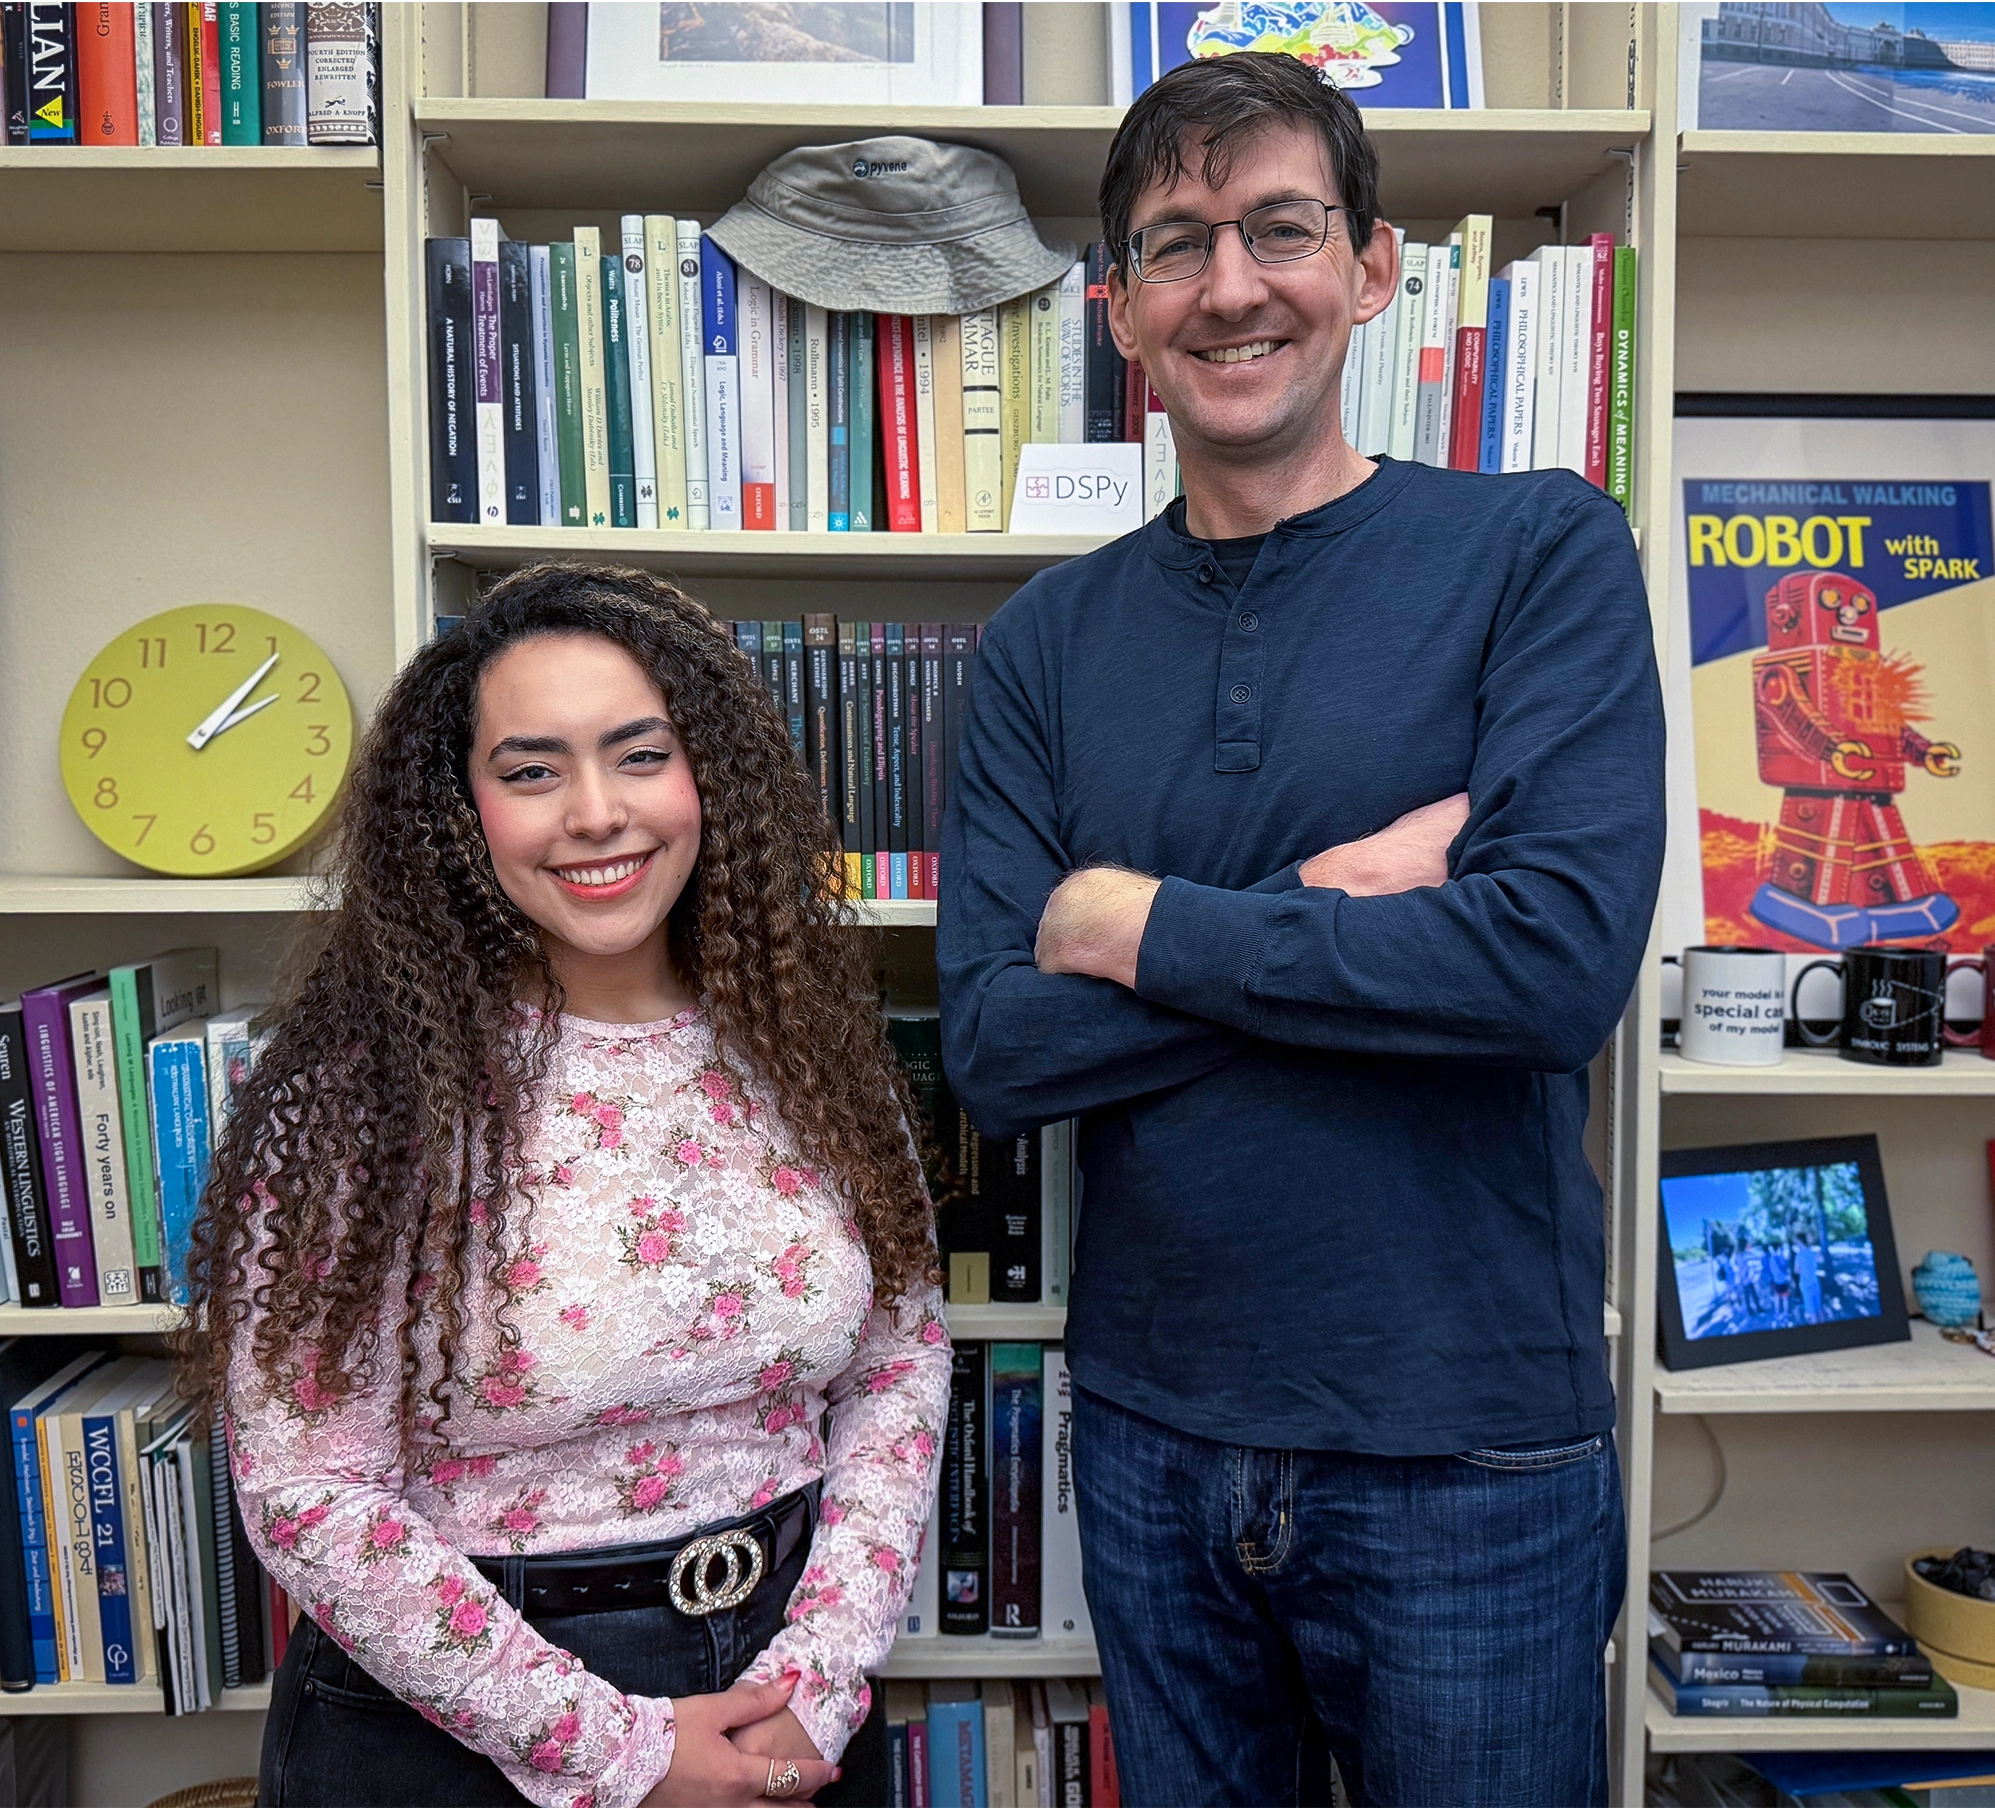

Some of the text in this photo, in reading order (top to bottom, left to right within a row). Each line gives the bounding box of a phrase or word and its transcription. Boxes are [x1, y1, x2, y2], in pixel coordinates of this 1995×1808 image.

[165, 20, 176, 104] Writers, and Teachers
[230, 14, 241, 90] BASIC READING
[267, 80, 306, 89] FOWLER
[41, 106, 62, 119] New
[869, 161, 908, 177] pyvene
[623, 236, 643, 245] SLAP
[677, 241, 700, 250] SLAP
[628, 258, 641, 269] 78
[683, 262, 695, 273] 81
[1405, 258, 1426, 268] SLAP
[585, 274, 593, 301] Objects
[1408, 279, 1421, 292] 74
[608, 269, 620, 343] Watts Politeness
[446, 325, 455, 364] NATURAL
[487, 314, 498, 360] The Proper
[748, 286, 761, 379] Logic in Grammar
[478, 314, 489, 397] Treatment of Events
[512, 343, 520, 381] SITUATIONS
[588, 337, 596, 367] Subjects
[792, 349, 802, 374] 1998
[1009, 320, 1023, 399] Investigations
[1060, 317, 1072, 408] WAY OF WORDS
[1071, 319, 1083, 402] STUDIES IN THE
[1463, 331, 1473, 368] AND LOGIC
[1471, 331, 1481, 386] COMPUTABILITY
[447, 365, 456, 400] HISTORY
[810, 338, 820, 428] Rullmann 1995
[919, 364, 930, 395] 1994
[1486, 320, 1502, 439] PHILOSOPHICAL PAPERS
[1513, 309, 1529, 435] PHILOSOPHICAL PAPERS
[448, 401, 456, 412] OF
[718, 381, 727, 402] Logic,
[1590, 331, 1605, 467] Boys Buying Two Sausages Each
[514, 397, 522, 431] ATTITUDES
[718, 402, 728, 436] Language
[1614, 329, 1629, 495] DYNAMICS of MEANING
[448, 413, 457, 456] NEGATION
[895, 375, 910, 499] IN THE ANALYSIS OF LINGUISTIC MEANING
[720, 451, 729, 482] Meaning
[617, 484, 625, 517] CAMBRIDGE
[755, 487, 763, 518] OXFORD
[1055, 474, 1130, 507] DSPy
[1701, 483, 1957, 506] MECHANICAL WALKING
[1687, 514, 1872, 567] ROBOT
[1884, 534, 1940, 557] with
[1903, 558, 1981, 580] SPARK
[195, 622, 236, 654] 12
[809, 627, 829, 635] OSTL
[138, 637, 167, 669] 11
[90, 677, 132, 709] 10
[296, 672, 322, 703] 2
[790, 660, 798, 704] MERCHANT
[81, 727, 107, 760] 9
[305, 725, 331, 756] 3
[845, 700, 856, 824] Continuations and Natural Language
[892, 725, 903, 828] Tense, Aspect, and Indexicality
[93, 777, 119, 809] 8
[287, 773, 316, 804] 4
[132, 814, 158, 847] 7
[189, 823, 216, 856] 6
[251, 812, 276, 845] 5
[865, 858, 873, 889] OXFORD
[879, 856, 887, 887] OXFORD
[895, 857, 903, 887] OXFORD
[912, 856, 920, 886] OXFORD
[931, 856, 939, 887] OXFORD
[161, 988, 193, 1017] Looking
[1702, 986, 1772, 1000] your model
[1694, 1003, 1759, 1021] special
[1709, 1022, 1723, 1033] of
[1726, 1025, 1746, 1036] my
[1, 1034, 12, 1081] Seuren
[37, 1023, 56, 1079] LINGUISTICS
[1896, 1042, 1929, 1052] SYSTEMS
[46, 1081, 57, 1094] OF
[46, 1095, 63, 1138] AMERICAN
[52, 1141, 64, 1163] SIGN
[94, 1113, 117, 1220] Forty years on
[1014, 1138, 1029, 1175] Analysis
[8, 1098, 41, 1257] WESTERN LINGUISTICS
[55, 1165, 71, 1210] LANGUAGE
[961, 1401, 977, 1535] The Oxford Handbook of
[1057, 1410, 1072, 1514] Pragmatics
[88, 1425, 115, 1548] WCCFL 21
[1721, 1640, 1791, 1653] MURAKAMI
[1693, 1667, 1740, 1681] Mexico
